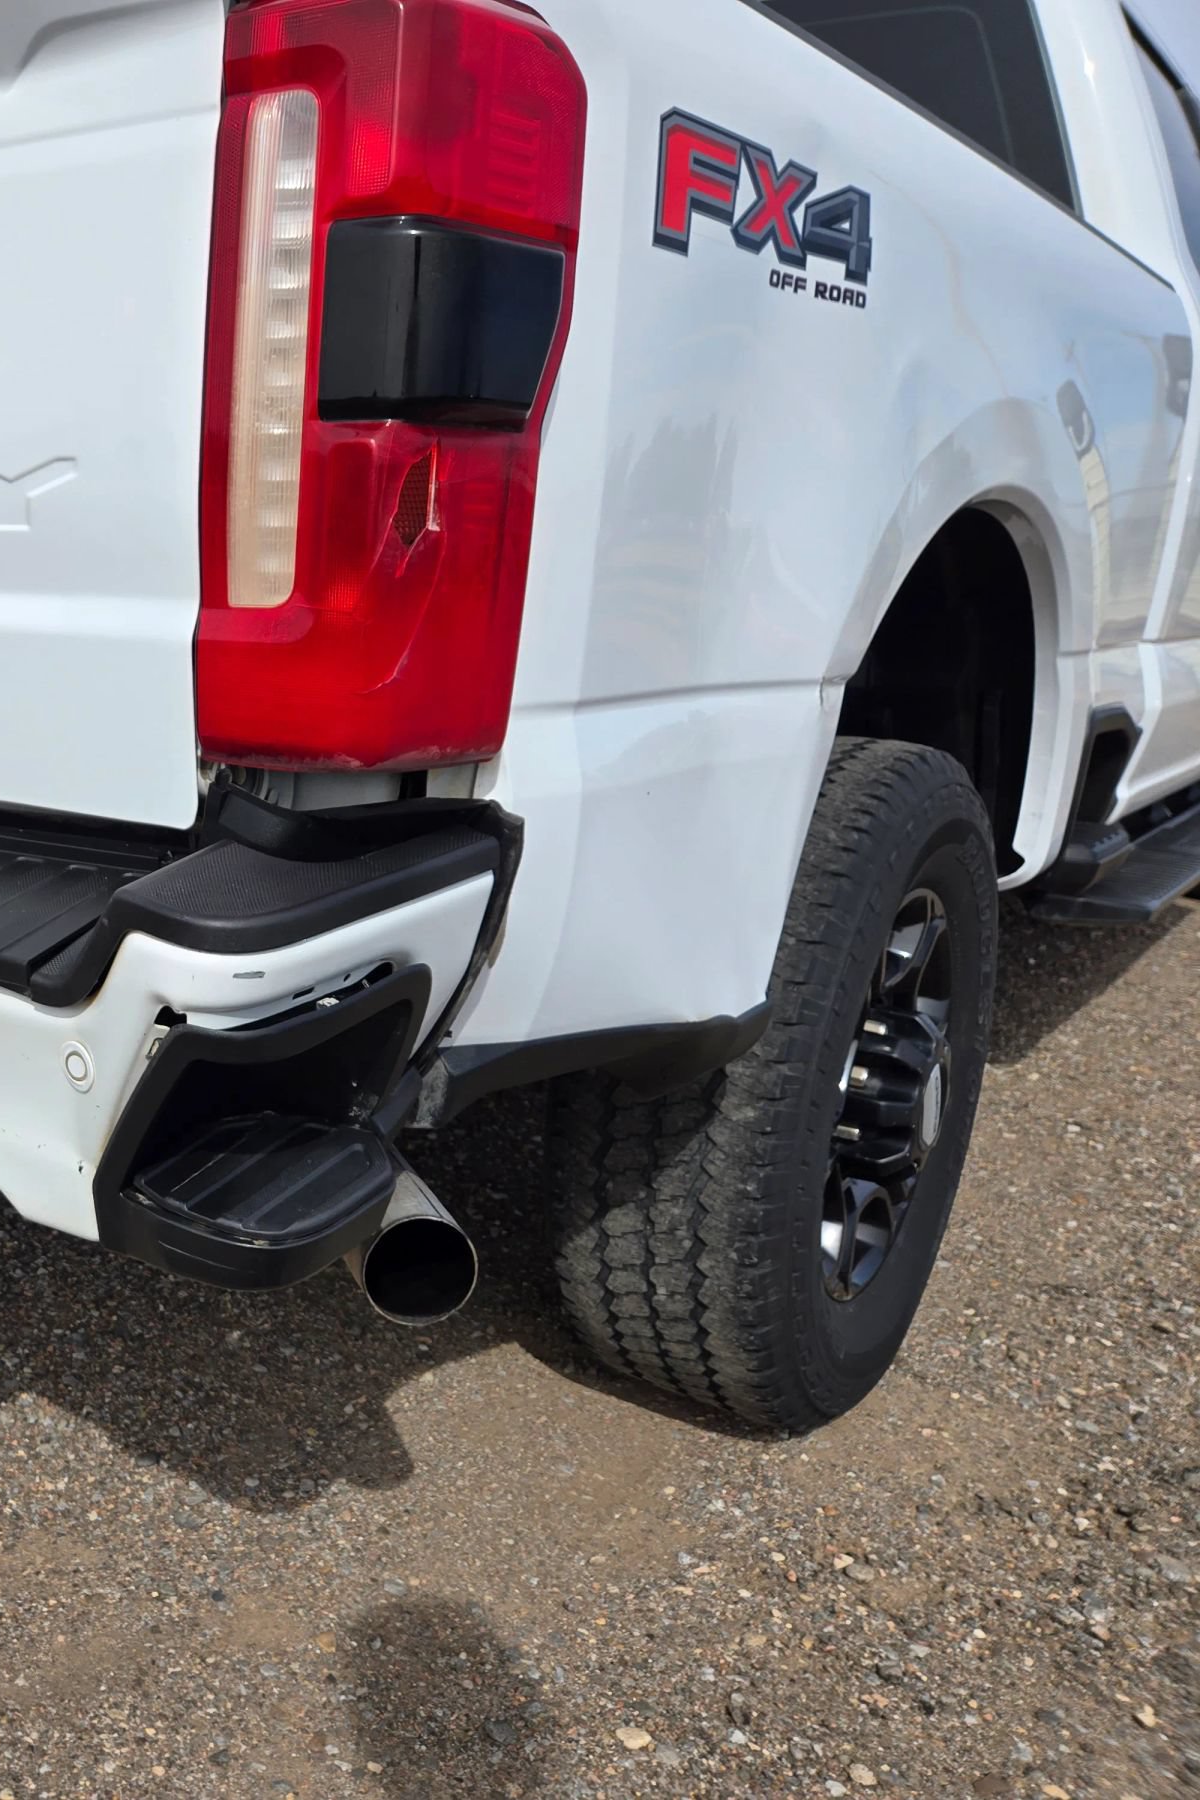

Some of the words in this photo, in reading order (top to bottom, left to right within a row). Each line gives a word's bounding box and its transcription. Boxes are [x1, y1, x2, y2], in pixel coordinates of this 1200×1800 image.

[652, 106, 872, 287] FX4
[768, 268, 808, 295] OFF
[813, 280, 868, 309] ROAD
